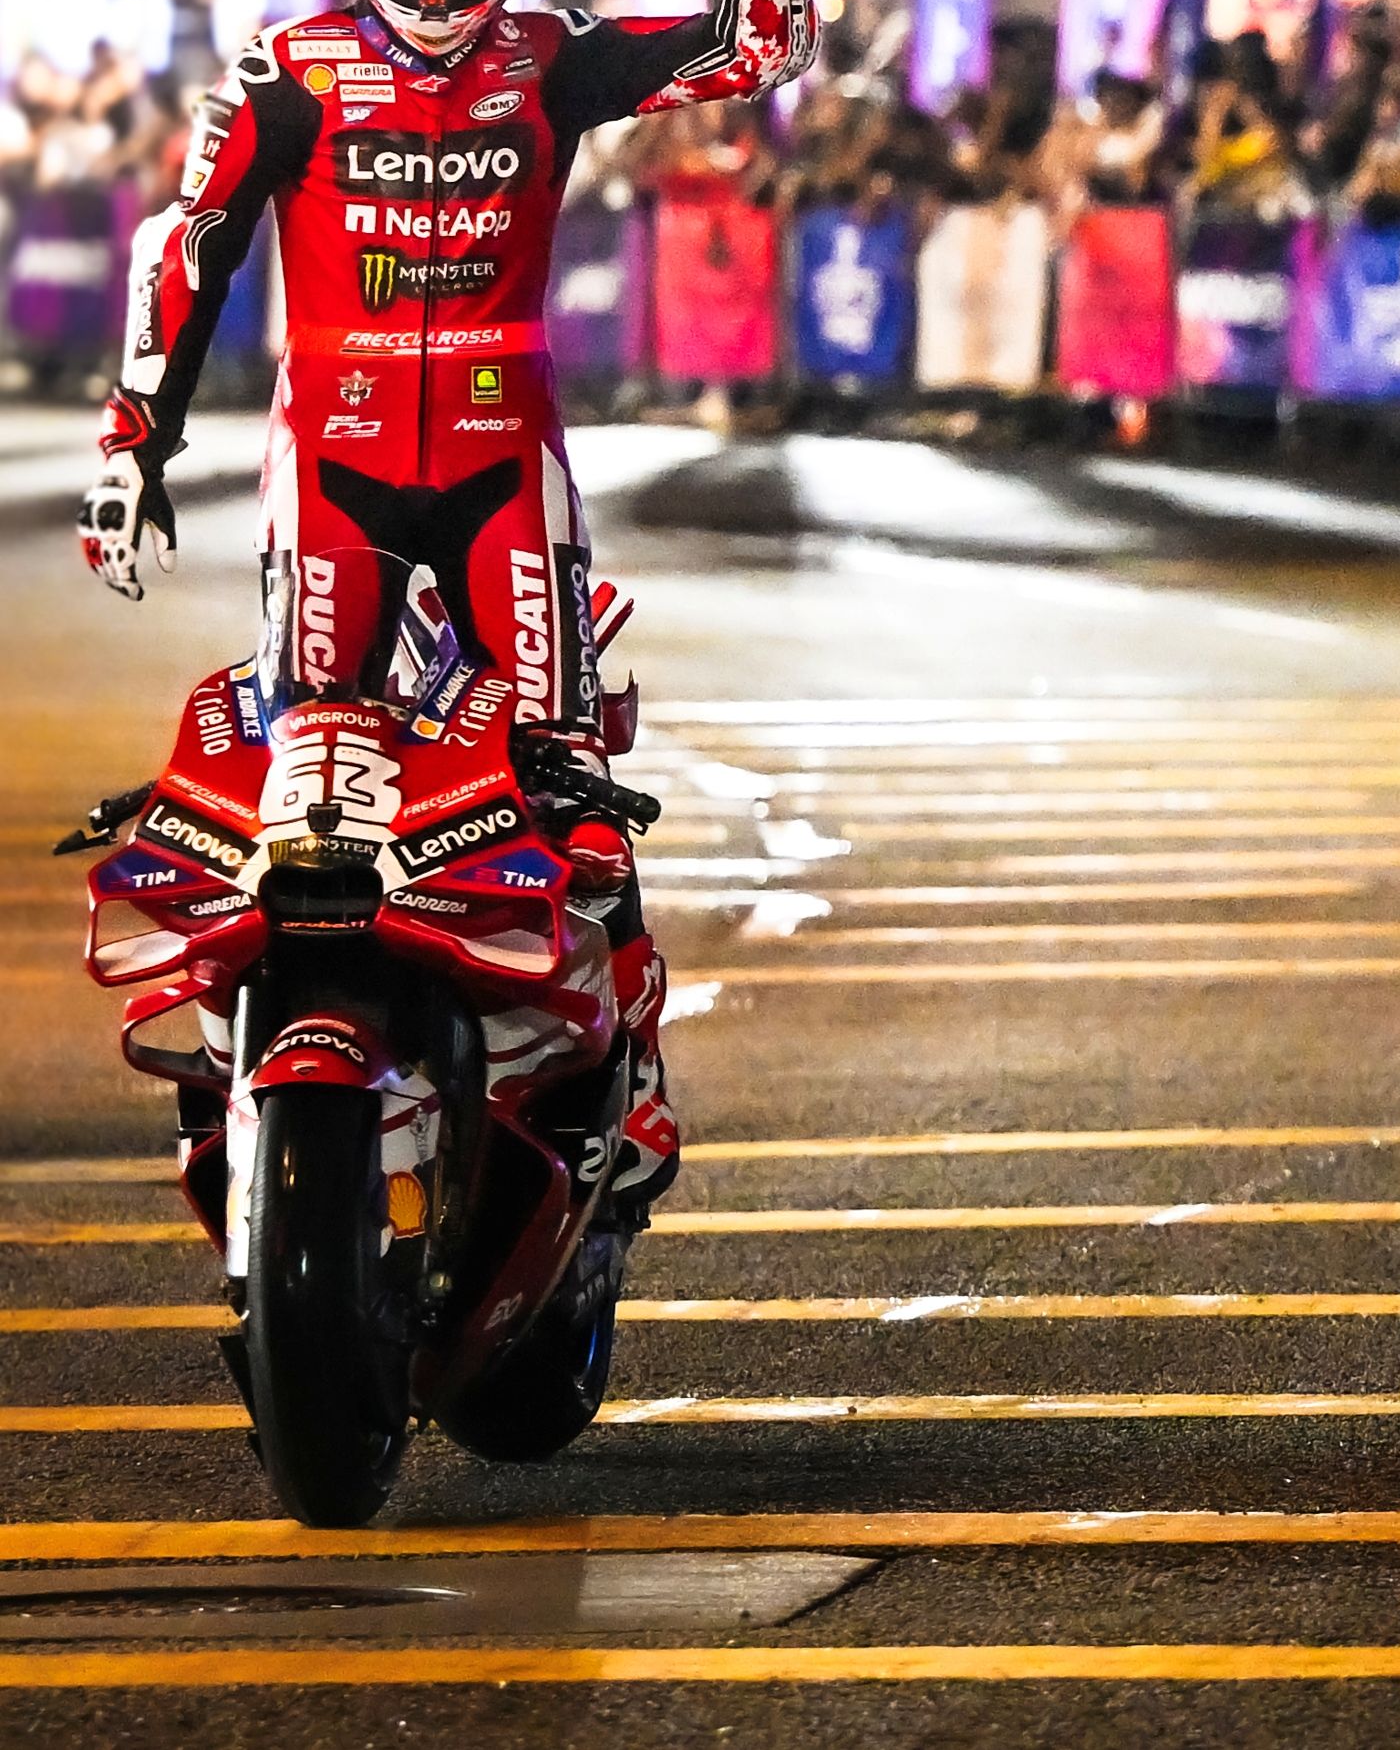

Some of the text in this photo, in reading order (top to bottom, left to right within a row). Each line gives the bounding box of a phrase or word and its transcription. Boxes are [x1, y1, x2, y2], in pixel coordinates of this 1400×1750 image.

[385, 43, 415, 69] TIM
[353, 65, 390, 77] riello
[342, 108, 372, 122] SAP
[476, 98, 518, 112] SUOMY
[347, 144, 520, 184] Lenovo
[385, 207, 512, 239] NetApp
[398, 262, 496, 284] MONSTER
[343, 328, 504, 348] FRECCIAROSSA
[453, 418, 523, 432] MotoGP
[510, 548, 550, 725] DUCATI
[571, 562, 598, 725] Lenovo
[459, 678, 513, 731] riello
[193, 696, 234, 756] riello
[259, 731, 402, 825] 63
[167, 774, 258, 821] FRECCIAROSSA
[402, 770, 508, 820] FRECCIAROSSA
[145, 804, 244, 867] Lenovo
[291, 837, 375, 856] MONSTER
[399, 808, 518, 867] Lenovo
[131, 868, 177, 889] TIM
[502, 870, 548, 889] TIM
[188, 893, 253, 916] CARRERA
[389, 890, 469, 914] CARRERA
[261, 1033, 366, 1067] Lenovo
